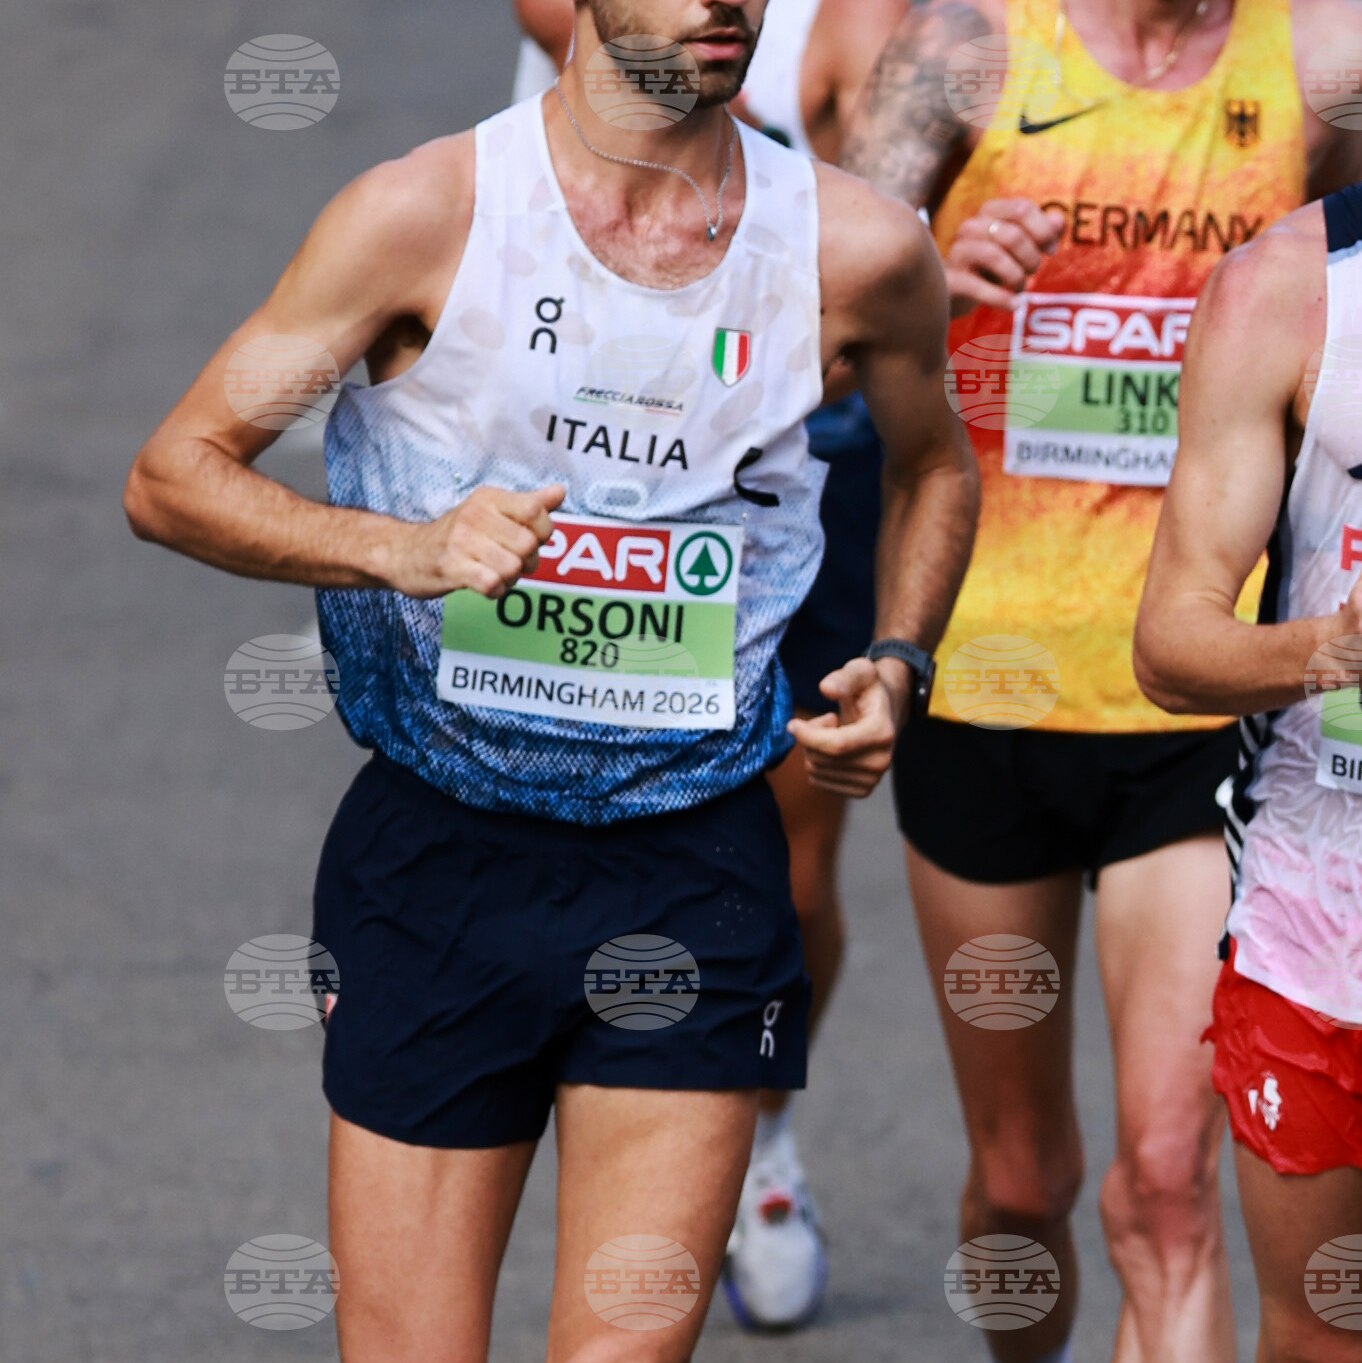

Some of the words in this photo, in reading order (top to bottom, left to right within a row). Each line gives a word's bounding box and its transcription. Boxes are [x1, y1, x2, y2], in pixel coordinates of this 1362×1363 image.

[575, 386, 684, 411] FRECCIAROSSA
[1081, 370, 1180, 407] LINK
[1116, 408, 1170, 434] 310
[546, 414, 688, 470] ITALIA
[1015, 439, 1178, 470] BIRMINGHA
[496, 589, 685, 644] ORSONI
[559, 637, 620, 669] 820
[451, 666, 645, 713] BIRMINGHAM
[652, 690, 721, 715] 2026
